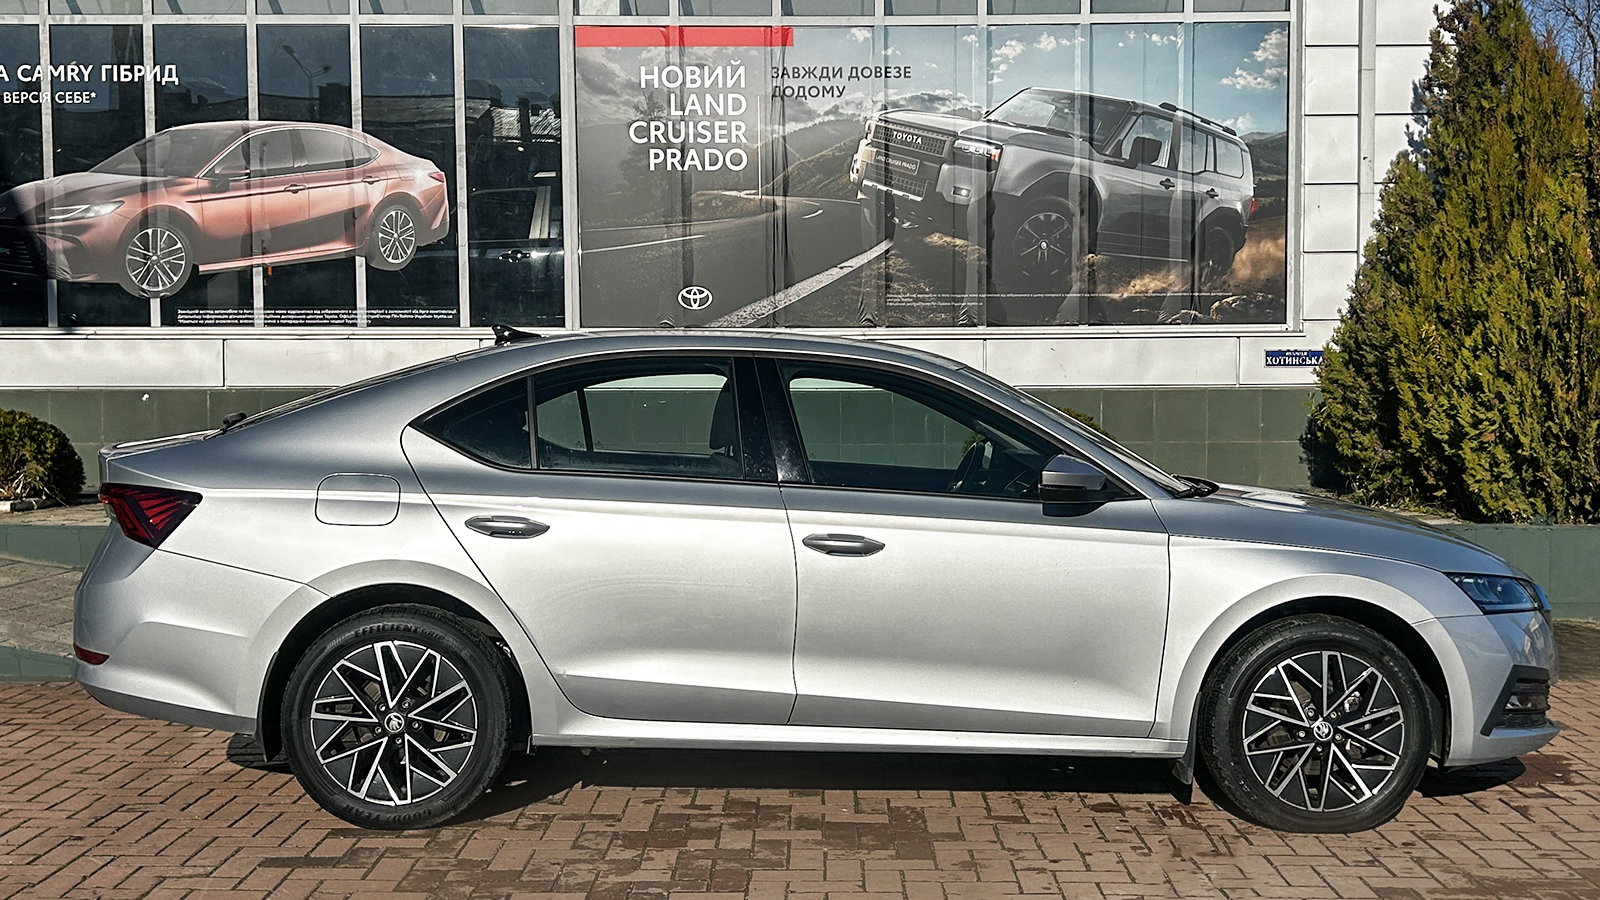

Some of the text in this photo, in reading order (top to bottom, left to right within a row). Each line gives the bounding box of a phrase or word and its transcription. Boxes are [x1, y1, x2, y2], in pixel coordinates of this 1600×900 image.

[17, 65, 93, 82] CAMRY
[101, 65, 178, 85] ГІБРИД
[640, 59, 746, 89] НОВИЙ
[771, 66, 912, 81] ЗАВЖДИ ДОВЕЗЕ
[4, 92, 50, 104] ВЕРСІЯ
[772, 85, 846, 100] ДОДОМУ
[669, 93, 747, 116] LAND
[628, 121, 748, 144] CRUISER
[892, 130, 922, 145] TOYOTA
[649, 148, 748, 171] PRADO
[901, 161, 916, 170] PRADO
